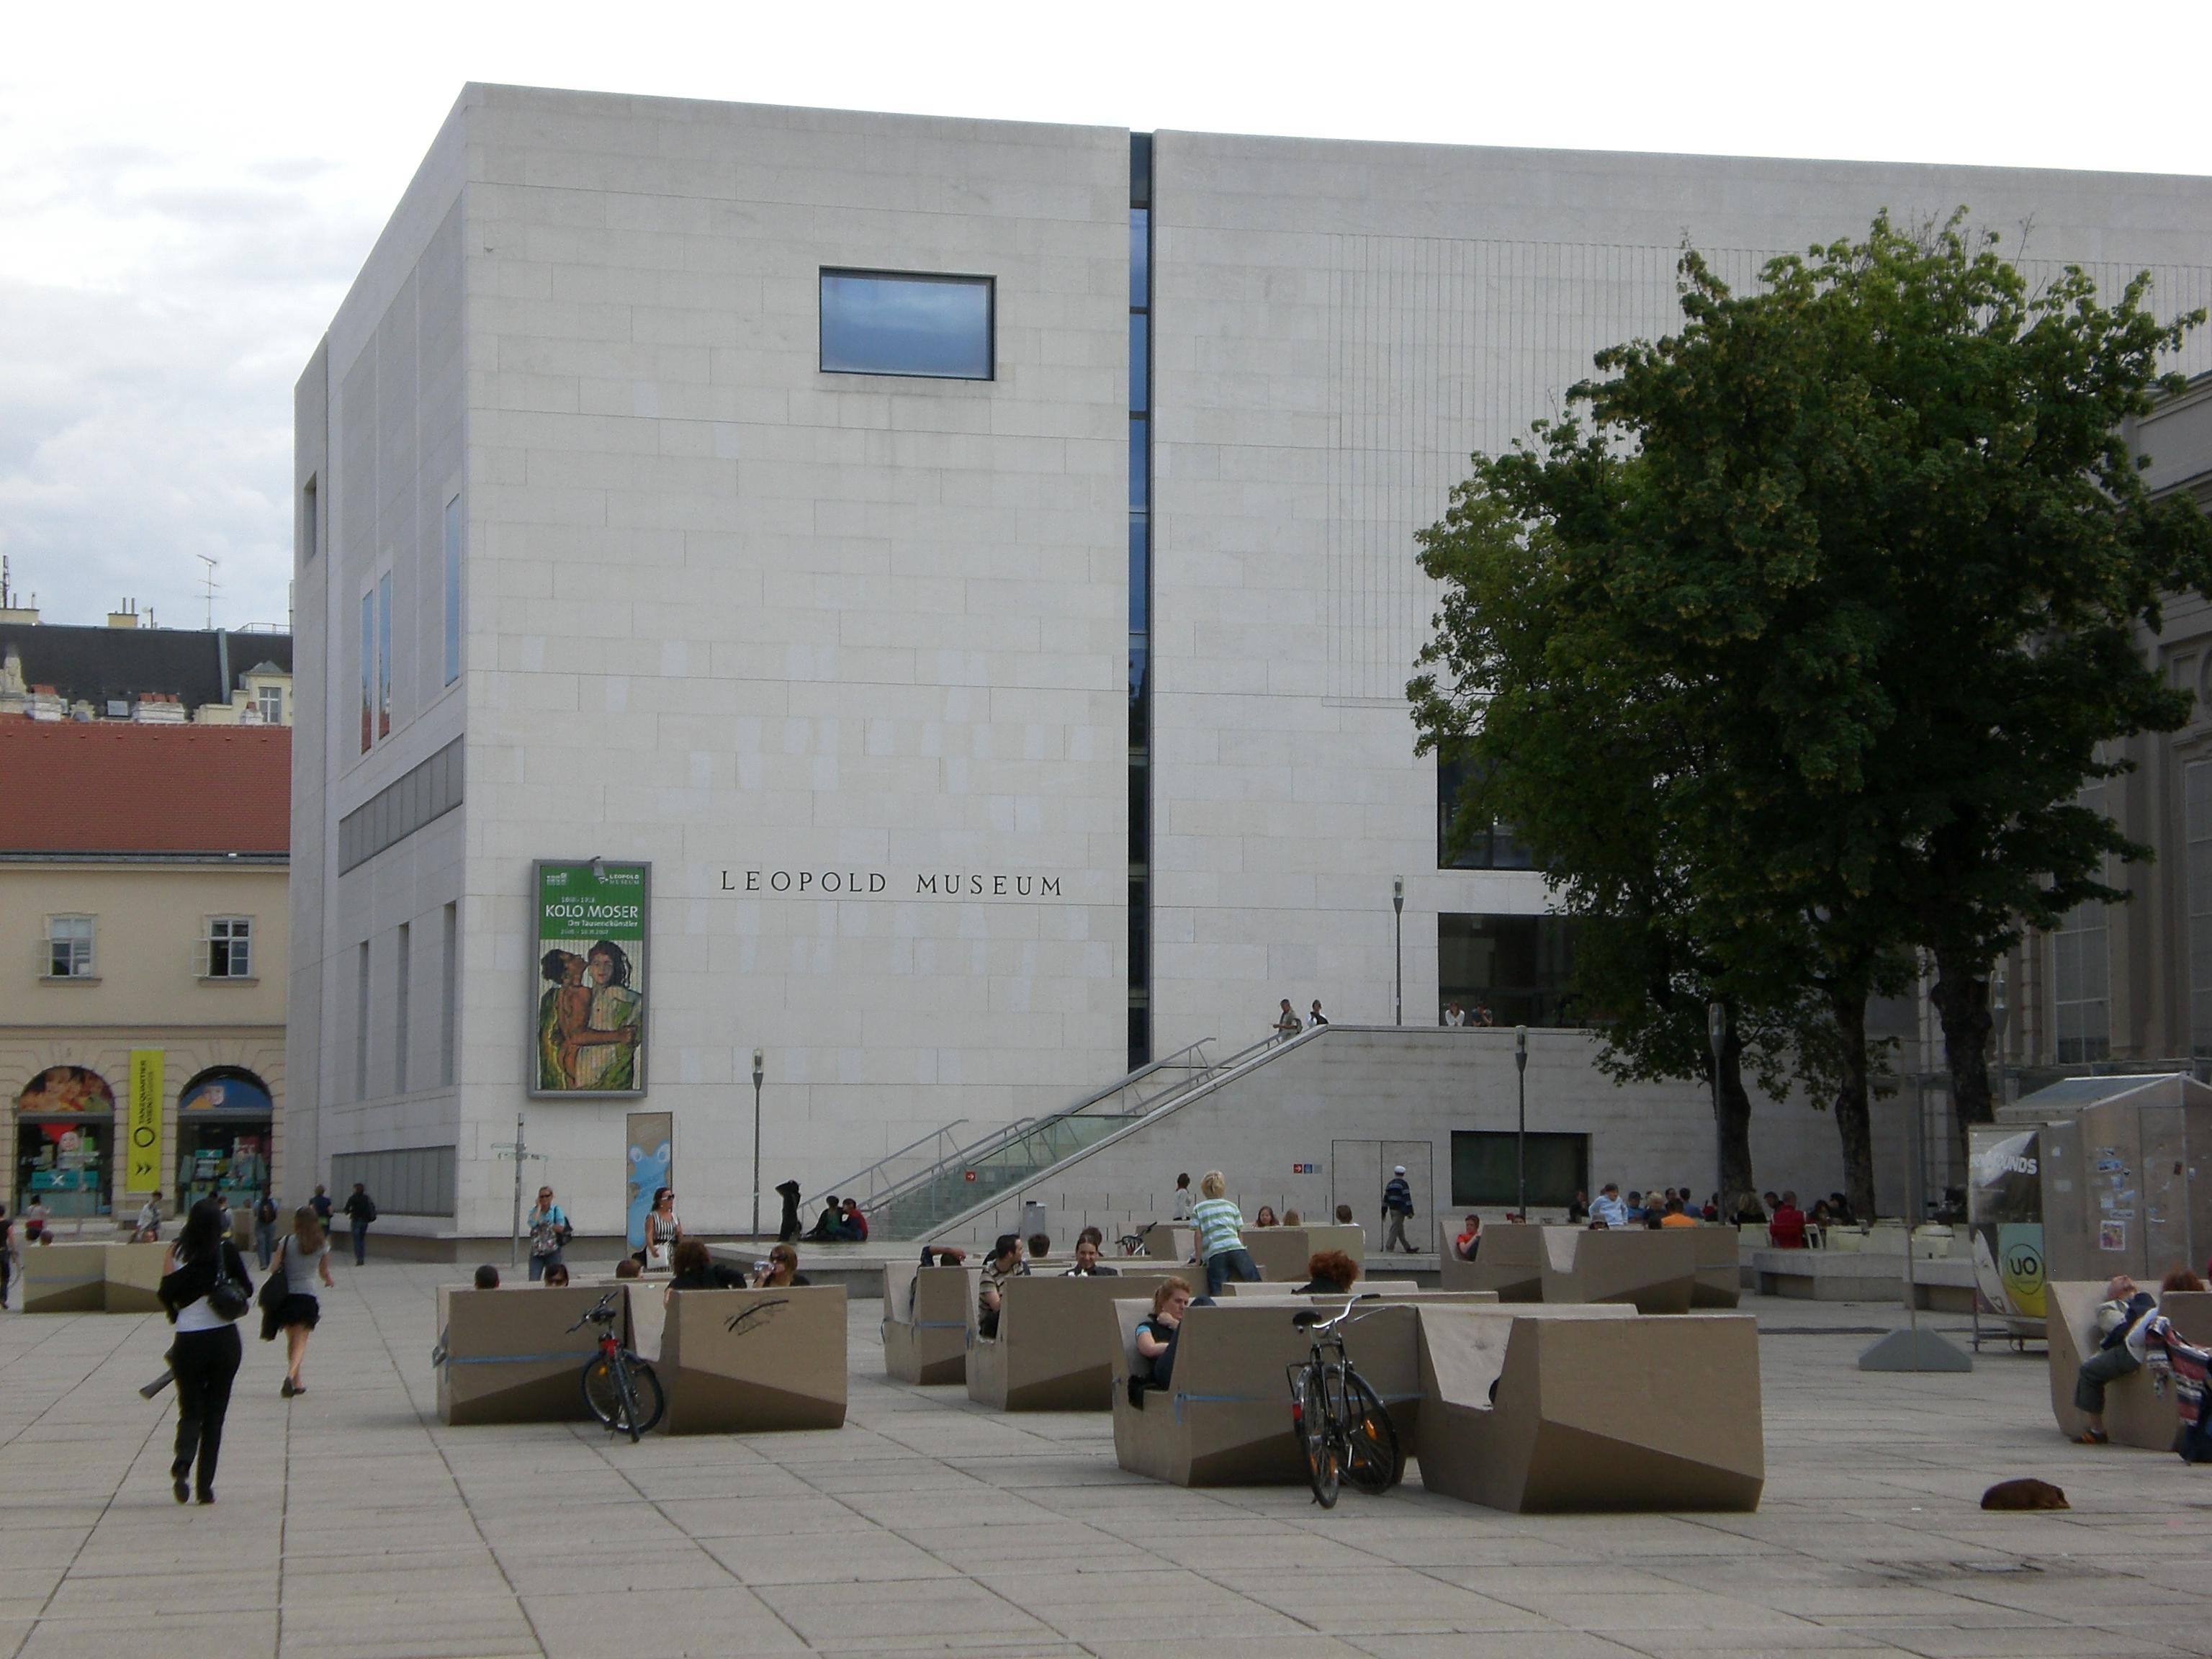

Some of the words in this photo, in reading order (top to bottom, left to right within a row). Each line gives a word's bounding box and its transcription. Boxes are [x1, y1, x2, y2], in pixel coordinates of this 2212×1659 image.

[721, 870, 887, 893] LEOPOLD
[915, 873, 1063, 897] MUSEUM
[545, 904, 585, 918] KOLO
[587, 905, 639, 919] MOSER
[2009, 1256, 2038, 1277] UO
